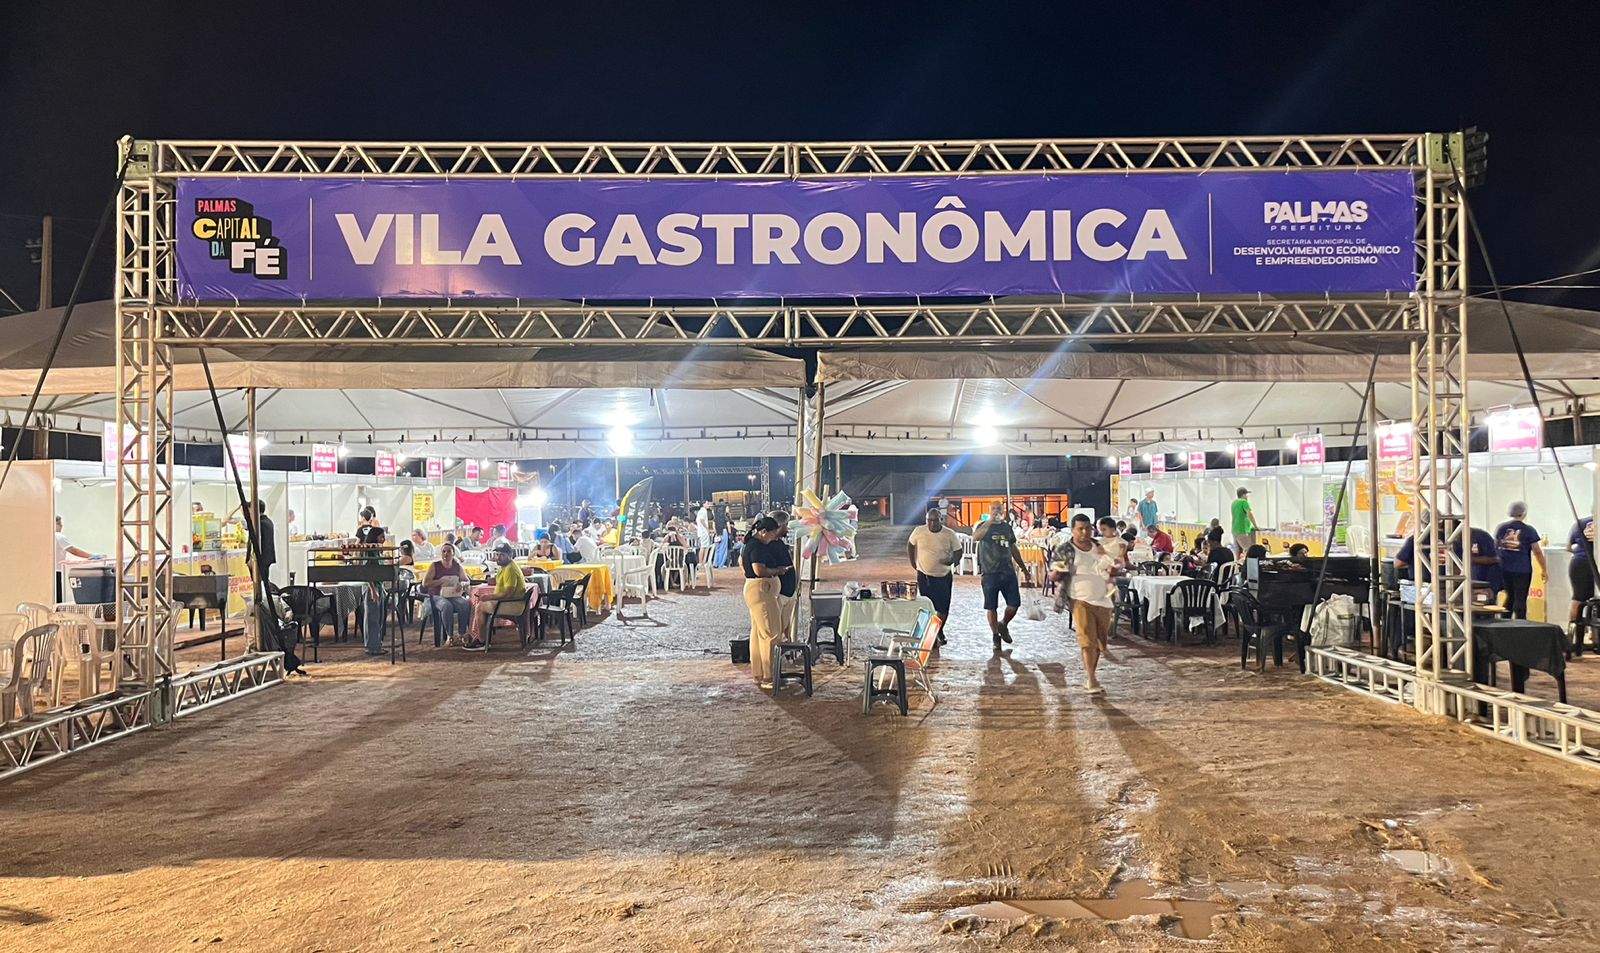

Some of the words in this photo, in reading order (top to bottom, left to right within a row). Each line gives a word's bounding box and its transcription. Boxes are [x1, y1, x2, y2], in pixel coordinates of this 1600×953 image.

[198, 200, 237, 212] PALMAS
[1264, 201, 1368, 223] PALMAS
[193, 218, 261, 239] CAPITAL
[335, 214, 522, 265] VILA
[544, 196, 1187, 266] GASTRONÔMICA
[211, 241, 225, 256] DA
[231, 238, 280, 274] FÉ
[1234, 246, 1334, 255] DESENVOLVIMENTO
[1336, 243, 1400, 254] ECONÔMICO
[1256, 256, 1263, 265] E
[1265, 256, 1378, 265] EMPREENDEDORISMO
